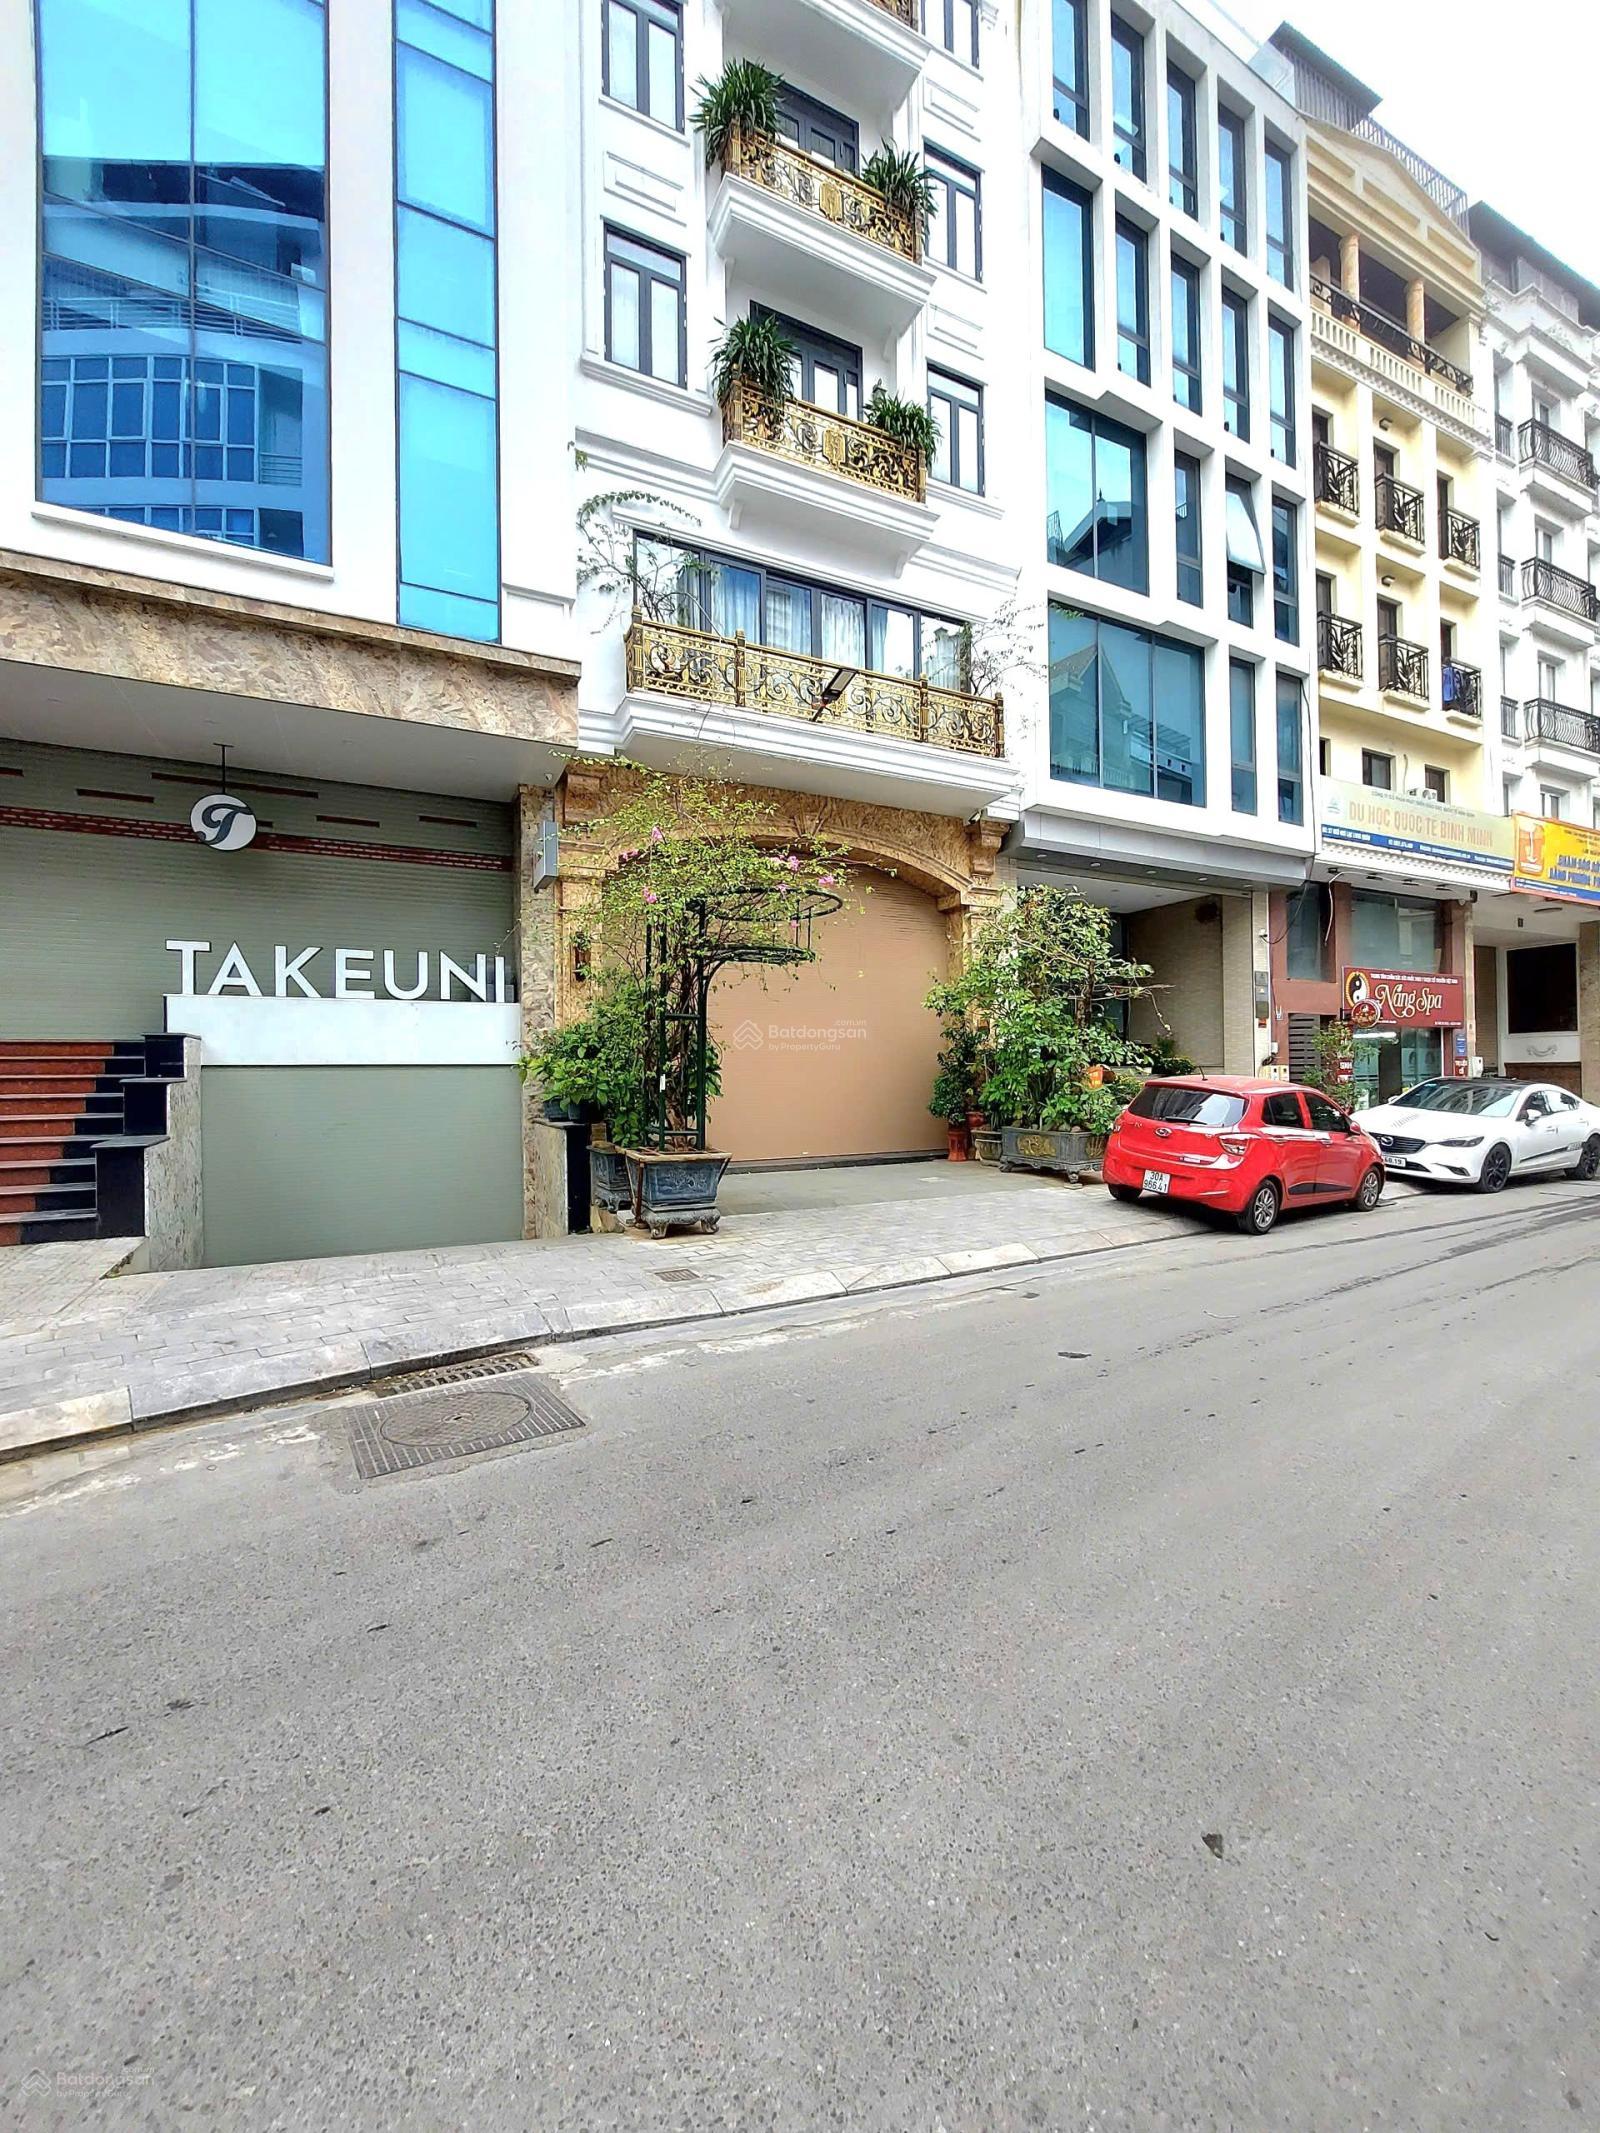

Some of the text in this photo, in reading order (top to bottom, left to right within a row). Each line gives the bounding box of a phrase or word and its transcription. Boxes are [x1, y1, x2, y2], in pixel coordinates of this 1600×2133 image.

[1349, 801, 1365, 822] DU
[165, 939, 506, 1004] TAKEUNI
[1416, 988, 1443, 1016] Spa
[1150, 1171, 1164, 1181] 30A
